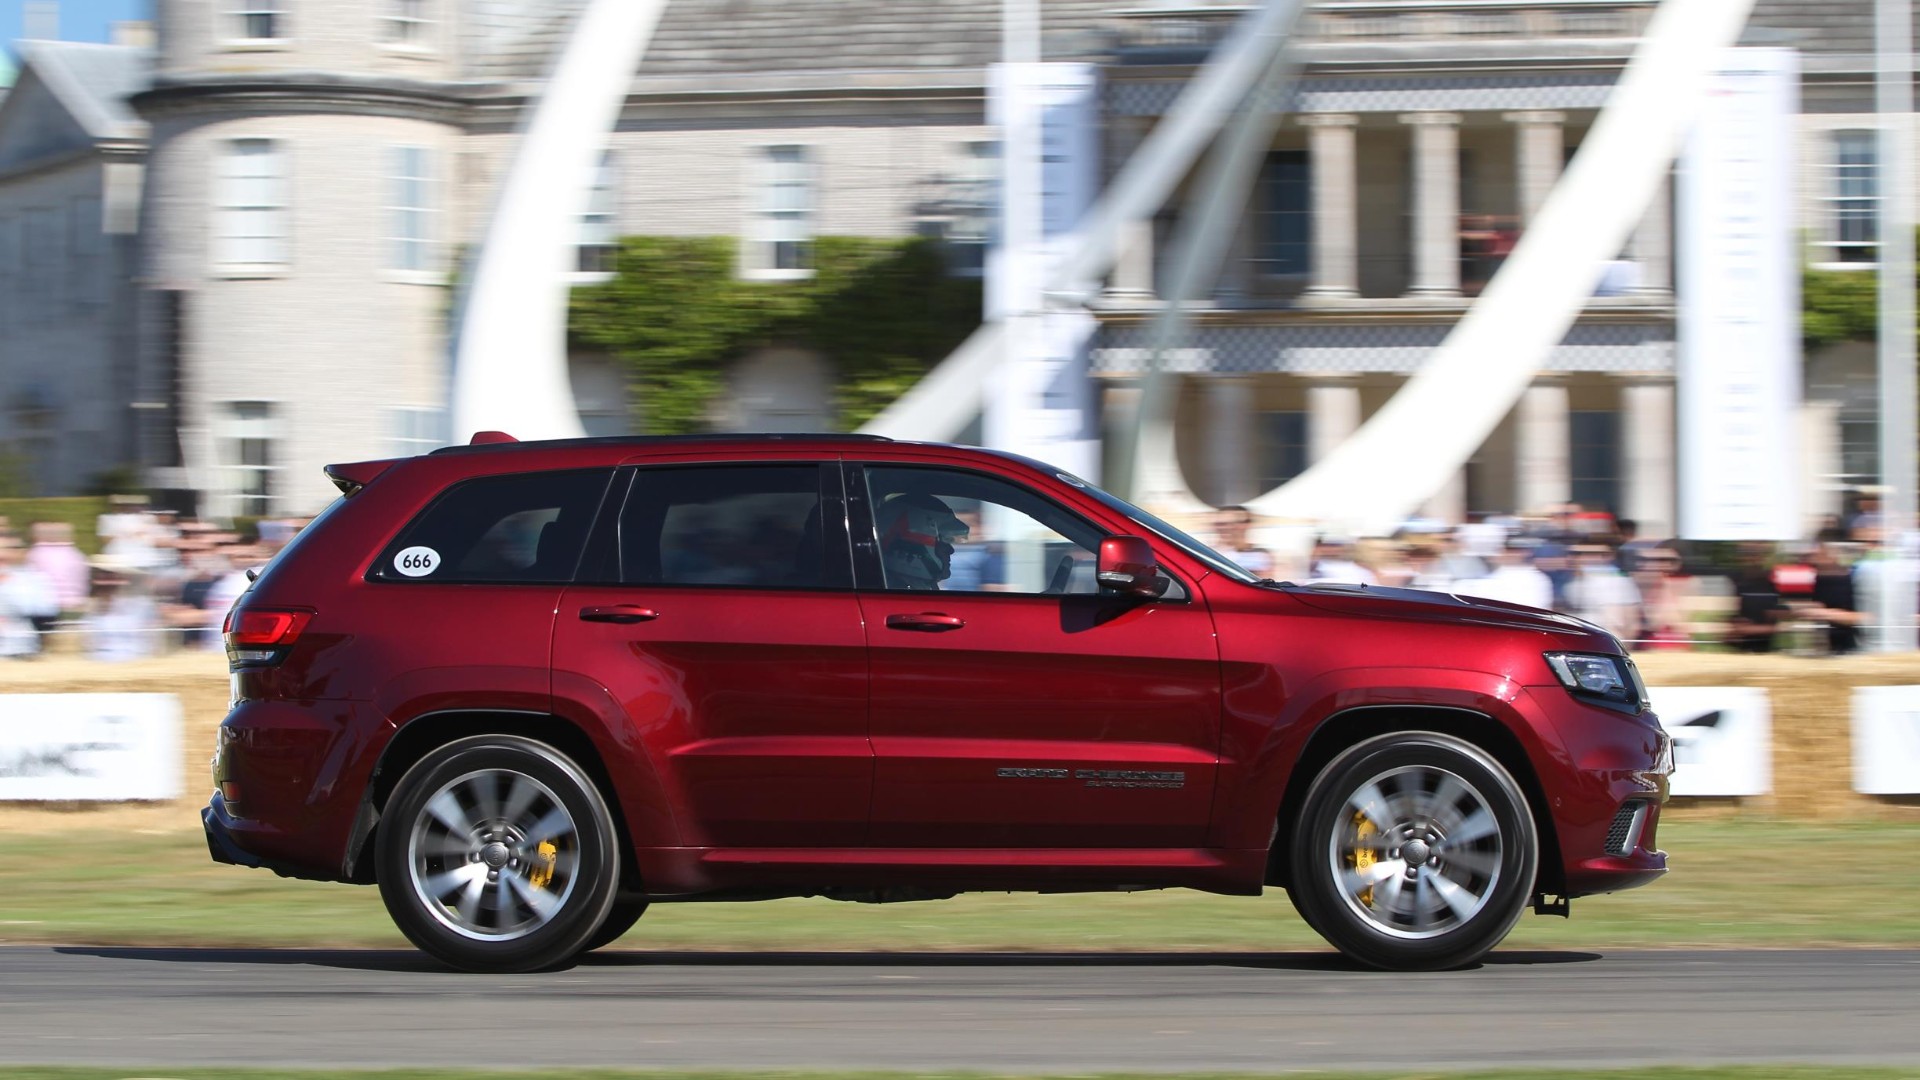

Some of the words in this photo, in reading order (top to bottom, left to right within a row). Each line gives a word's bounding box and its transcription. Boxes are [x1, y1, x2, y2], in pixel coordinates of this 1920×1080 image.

[403, 554, 431, 568] 666
[997, 767, 1068, 778] GRAND
[1075, 769, 1185, 781] CHEROKEE
